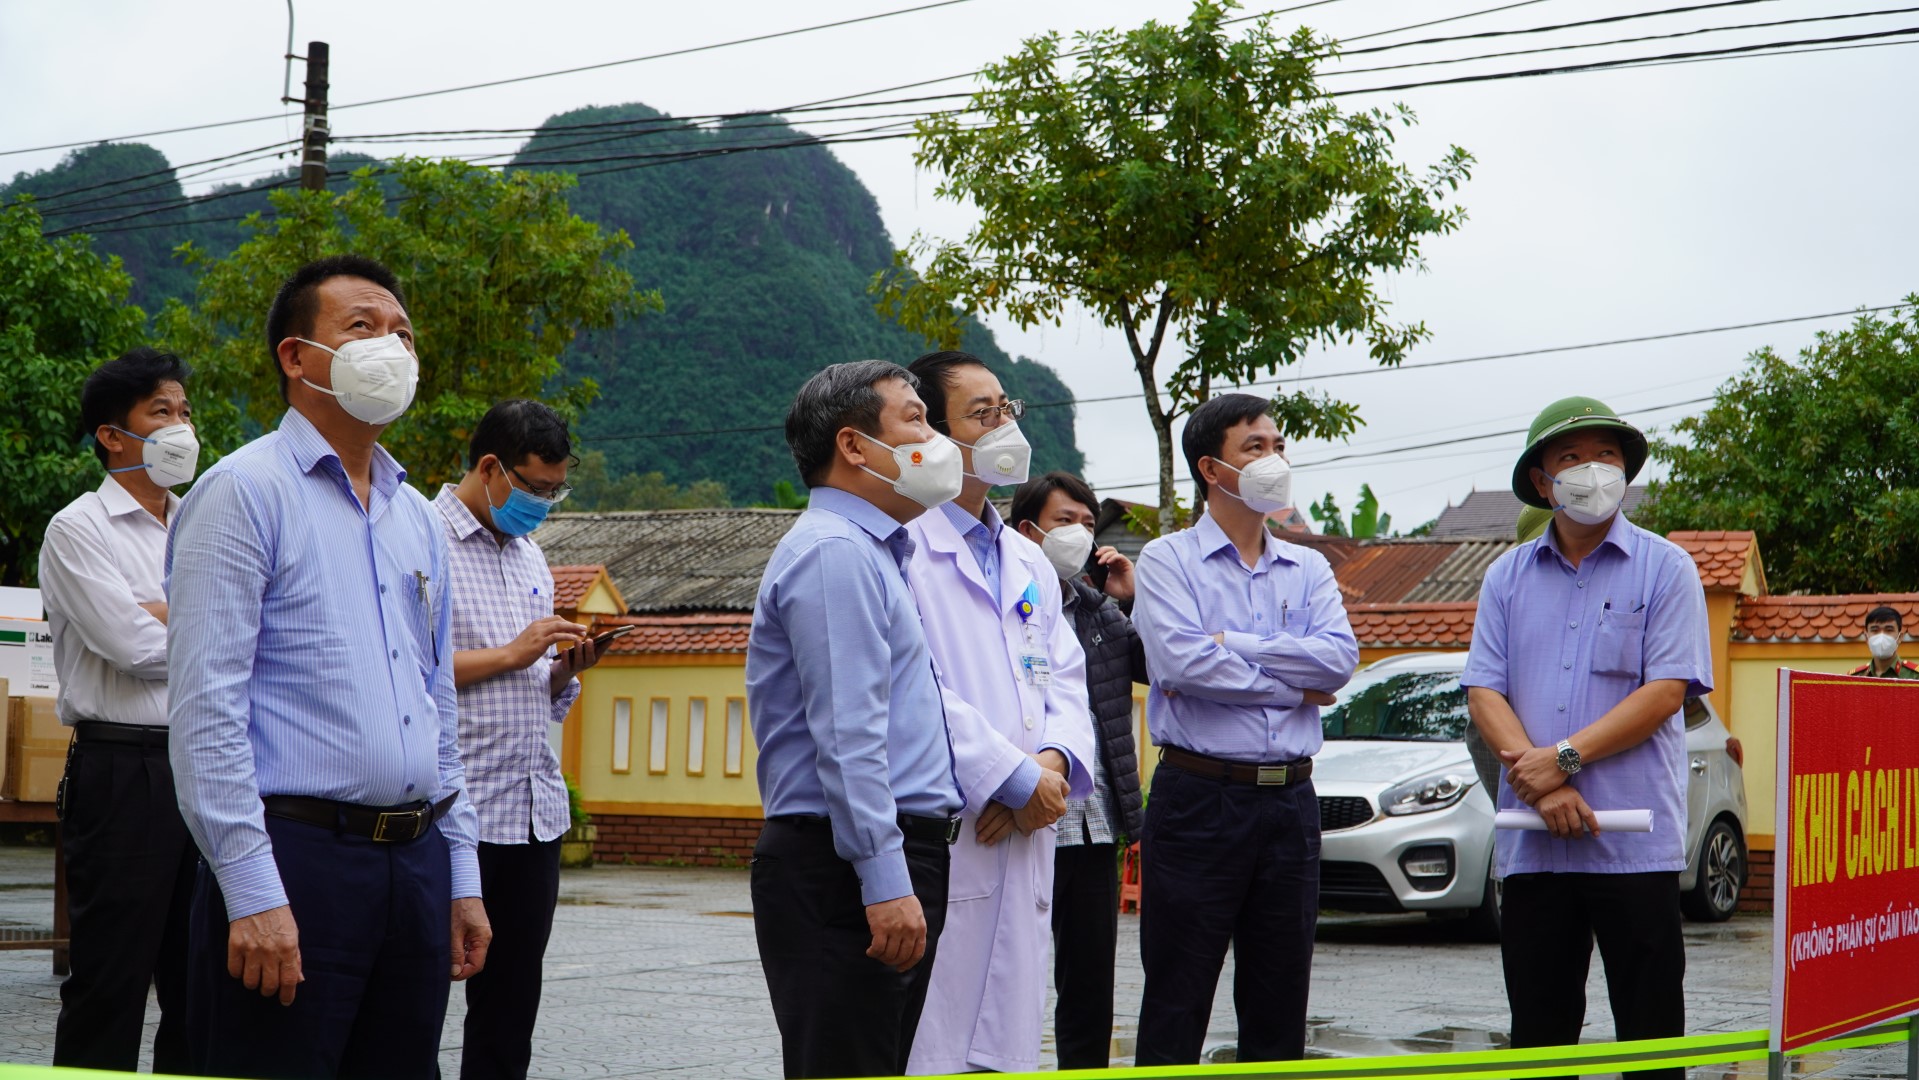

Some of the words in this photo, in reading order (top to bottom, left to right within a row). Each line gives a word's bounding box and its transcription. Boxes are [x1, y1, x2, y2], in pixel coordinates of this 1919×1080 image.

[1793, 772, 1839, 887] KHU
[1845, 746, 1899, 880] CÁCH
[1791, 921, 1834, 972] (KHÔNG
[1836, 914, 1863, 958] PHẬN
[1864, 913, 1878, 953] SỰ
[1878, 901, 1899, 942] CẤM
